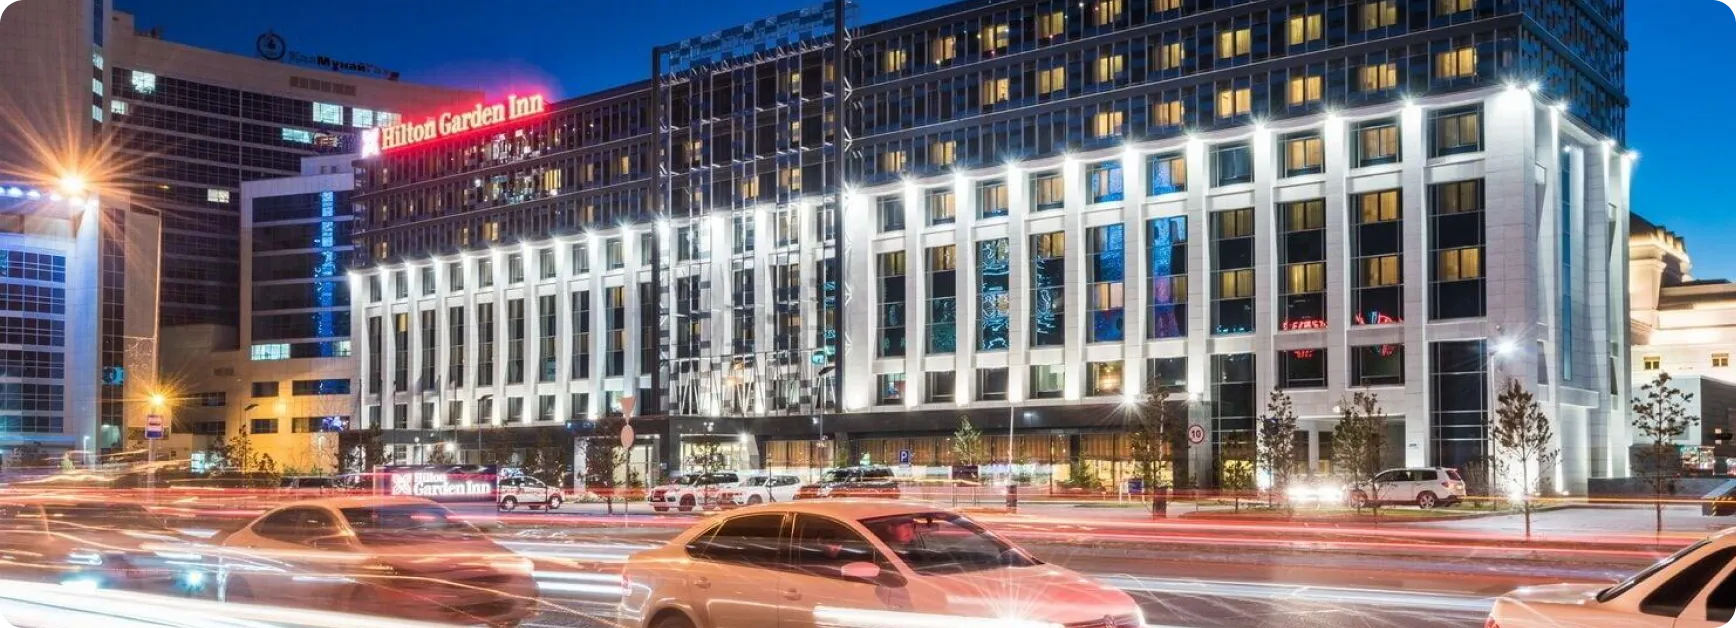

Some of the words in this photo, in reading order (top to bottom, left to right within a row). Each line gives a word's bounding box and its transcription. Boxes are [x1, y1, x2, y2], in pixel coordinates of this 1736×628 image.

[381, 119, 436, 150] Hilton
[439, 104, 505, 135] Garden
[509, 94, 543, 118] Inn
[1191, 430, 1202, 439] 10
[900, 451, 908, 462] P
[413, 481, 466, 496] Garden
[467, 481, 491, 495] Inn
